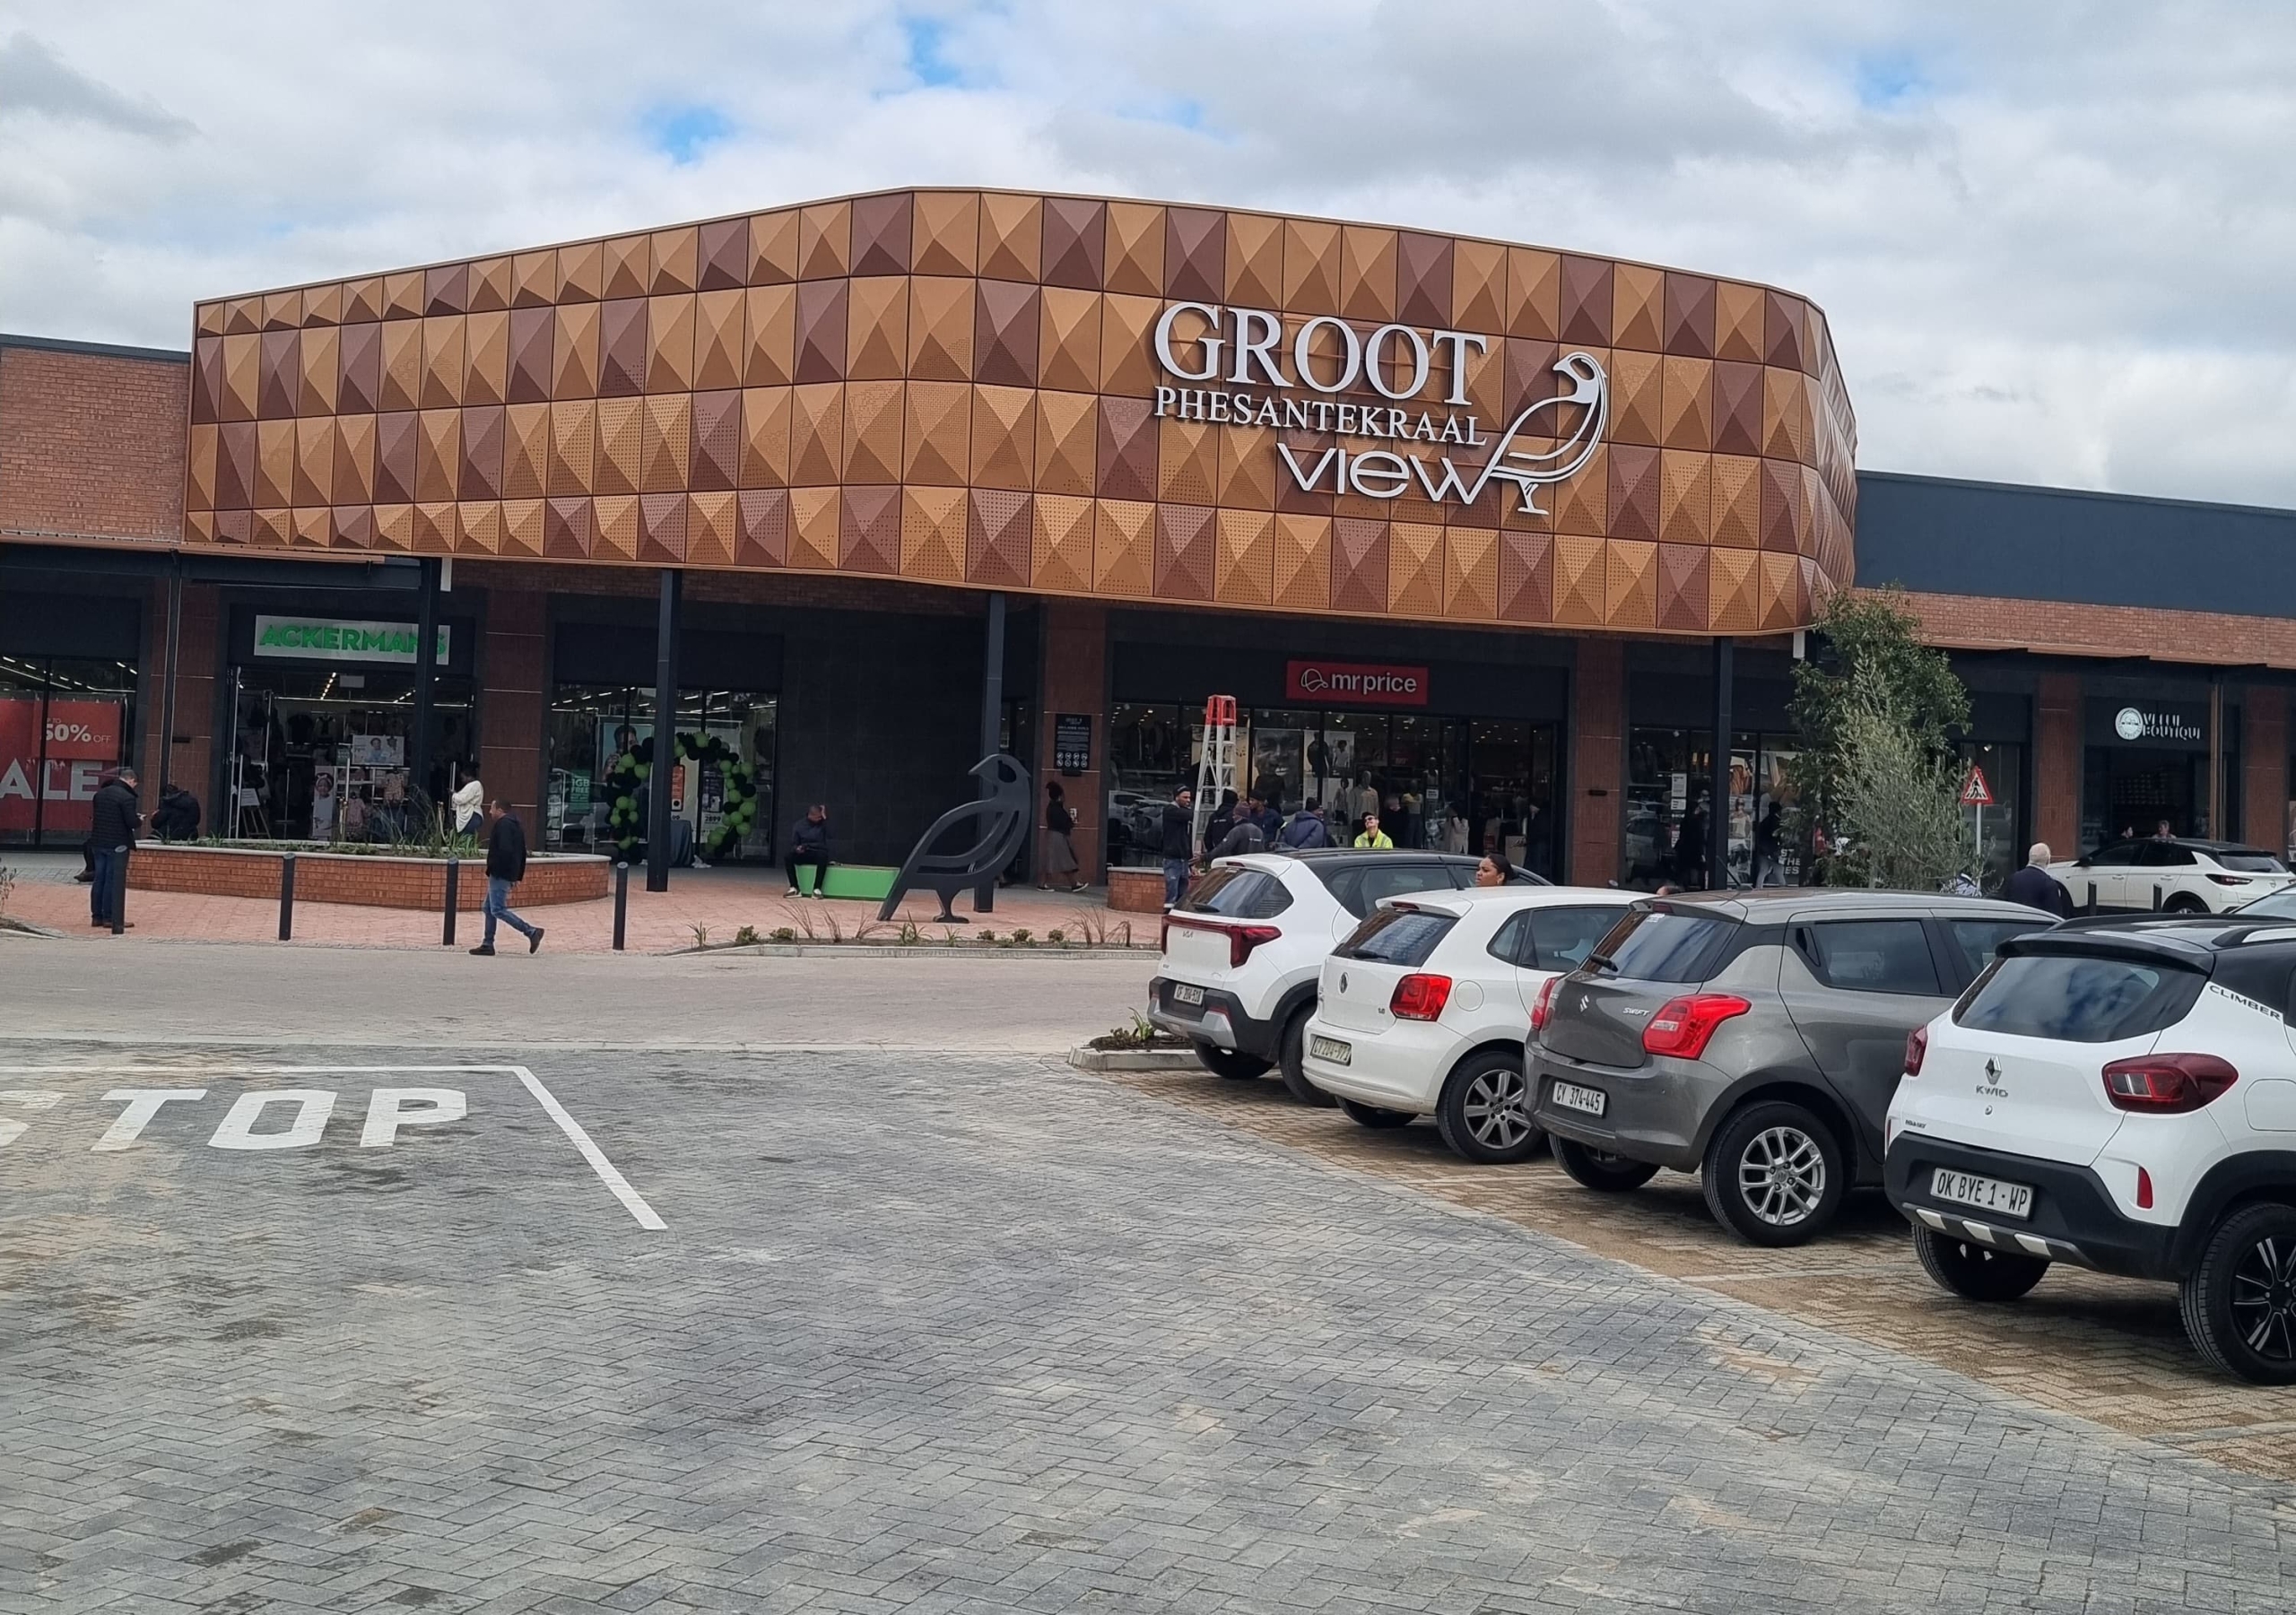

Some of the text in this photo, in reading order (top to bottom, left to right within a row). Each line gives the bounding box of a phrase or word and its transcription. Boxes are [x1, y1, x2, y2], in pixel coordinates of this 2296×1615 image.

[1154, 301, 1486, 406] GROOT
[1154, 386, 1487, 447] PHESANTEKRAAL
[46, 724, 111, 743] 50% OFF
[1622, 1007, 1650, 1017] SWIFT
[2209, 985, 2281, 1021] CLIMBER
[1556, 1081, 1601, 1111] CY 374-445
[1975, 1085, 2009, 1098] KWID
[1937, 1172, 1956, 1197] OK
[1957, 1176, 1985, 1203] BYE
